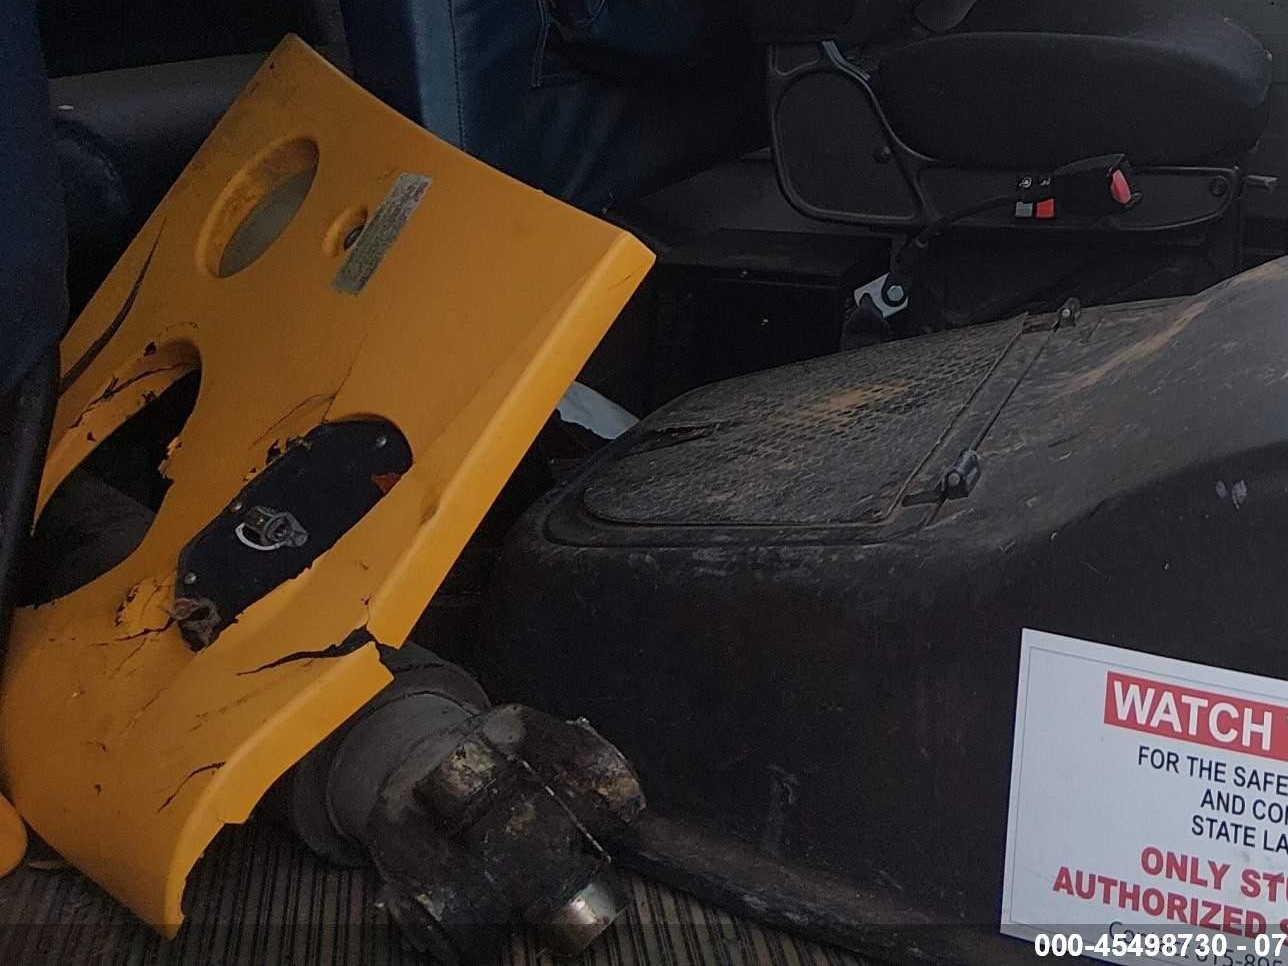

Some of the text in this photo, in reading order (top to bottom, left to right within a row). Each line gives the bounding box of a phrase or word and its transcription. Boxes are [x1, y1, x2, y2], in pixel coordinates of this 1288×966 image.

[1113, 681, 1272, 751] WATCH
[1138, 745, 1180, 774] FOR
[1186, 755, 1227, 784] THE
[1200, 788, 1246, 815] AND
[1191, 814, 1257, 847] STATE
[1141, 846, 1232, 891] ONLY
[1052, 866, 1267, 940] AUTHORIZED
